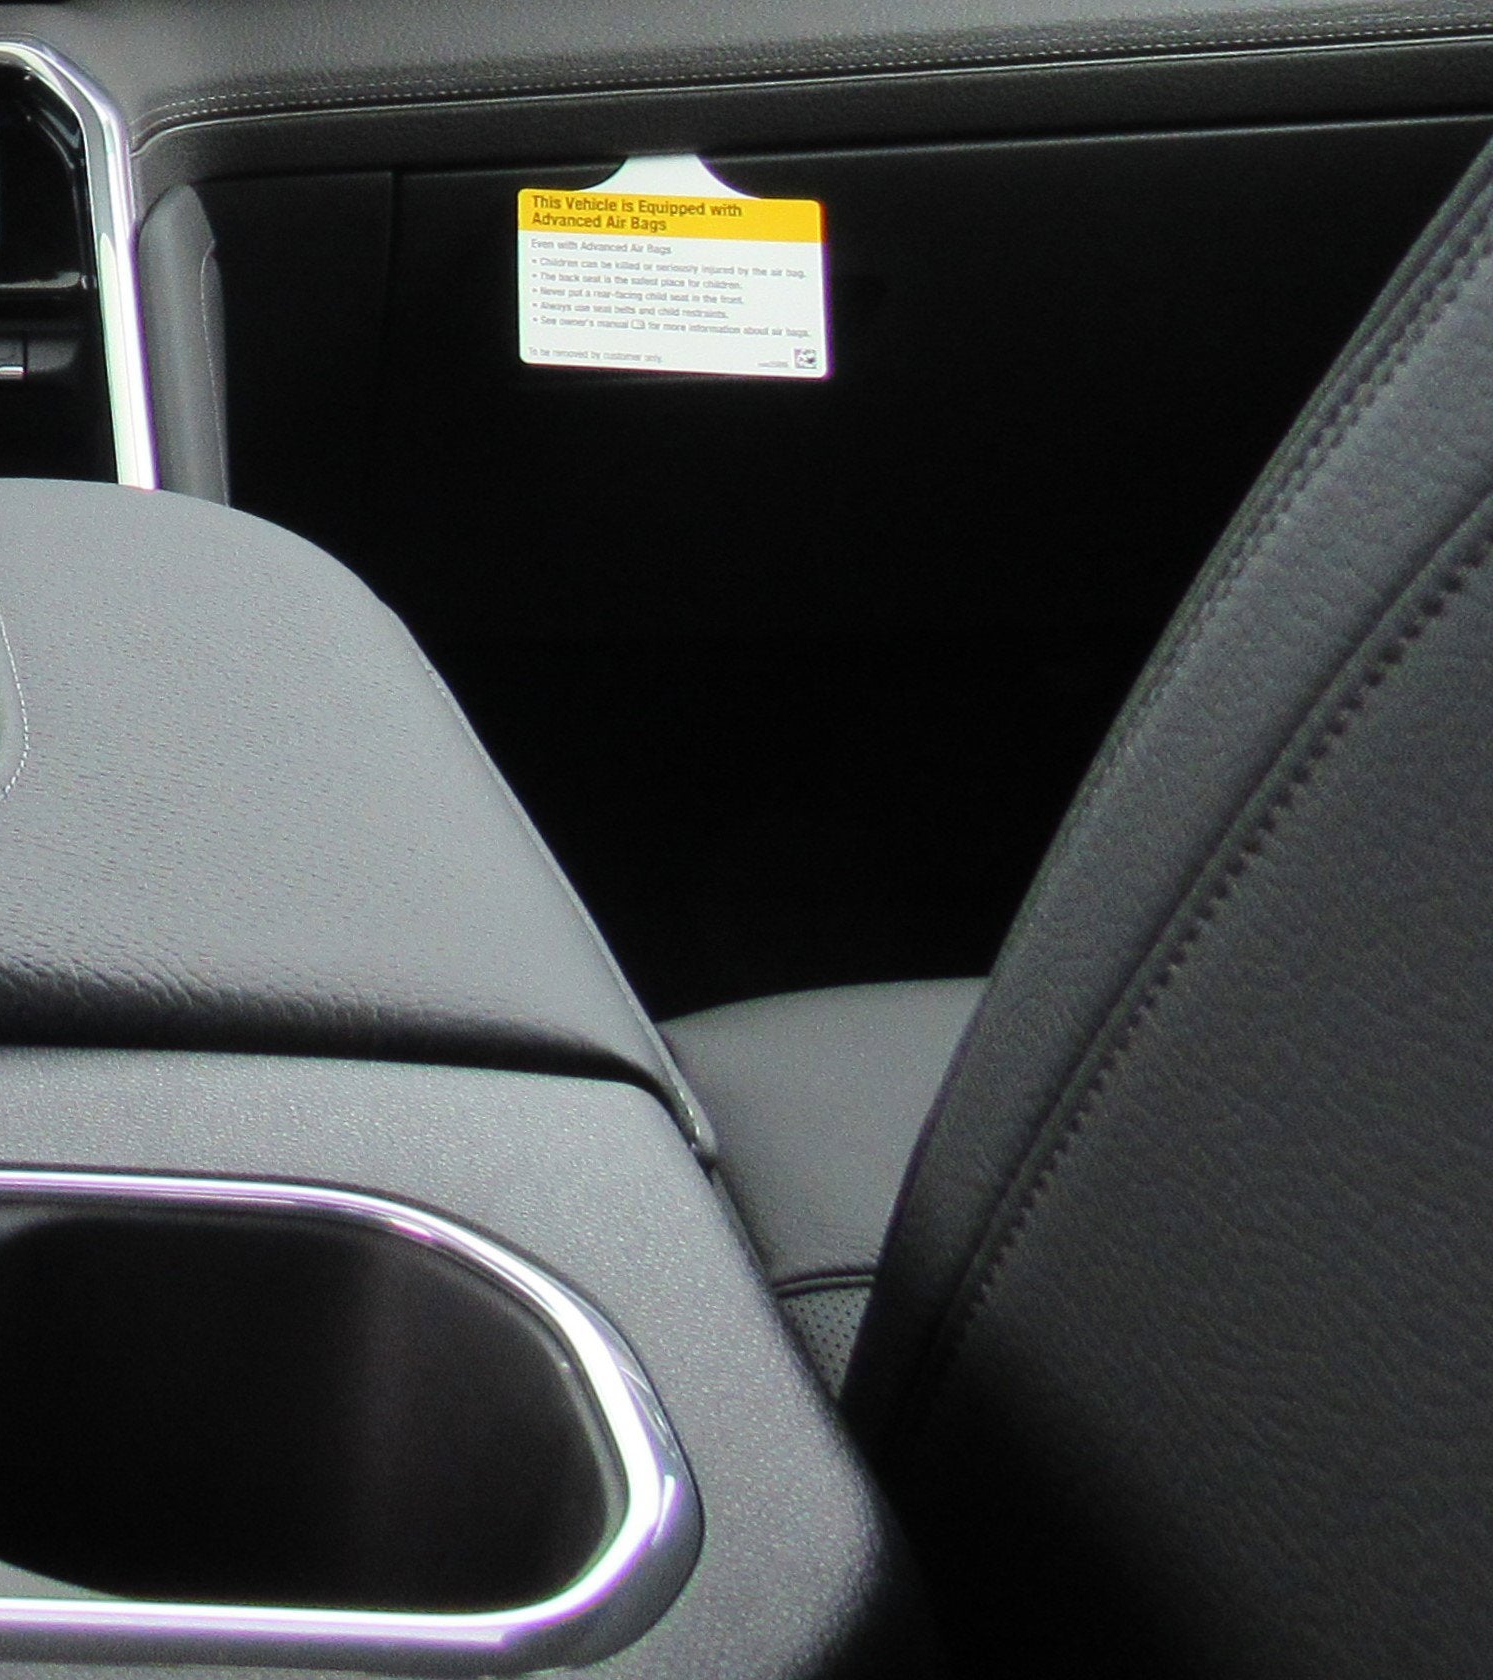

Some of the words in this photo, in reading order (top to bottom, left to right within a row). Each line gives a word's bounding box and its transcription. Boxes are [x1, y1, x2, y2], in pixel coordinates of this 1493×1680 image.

[532, 195, 561, 209] This
[566, 197, 617, 212] Vehicle
[621, 200, 633, 212] is
[638, 200, 705, 216] Equipped
[710, 204, 742, 216] with
[532, 212, 601, 228] Advanced
[606, 216, 626, 229] Air
[631, 217, 667, 233] Bags
[531, 239, 554, 249] Even
[557, 240, 578, 250] with
[581, 242, 627, 252] Advanced
[630, 244, 644, 253] Air
[647, 244, 671, 255] Bags
